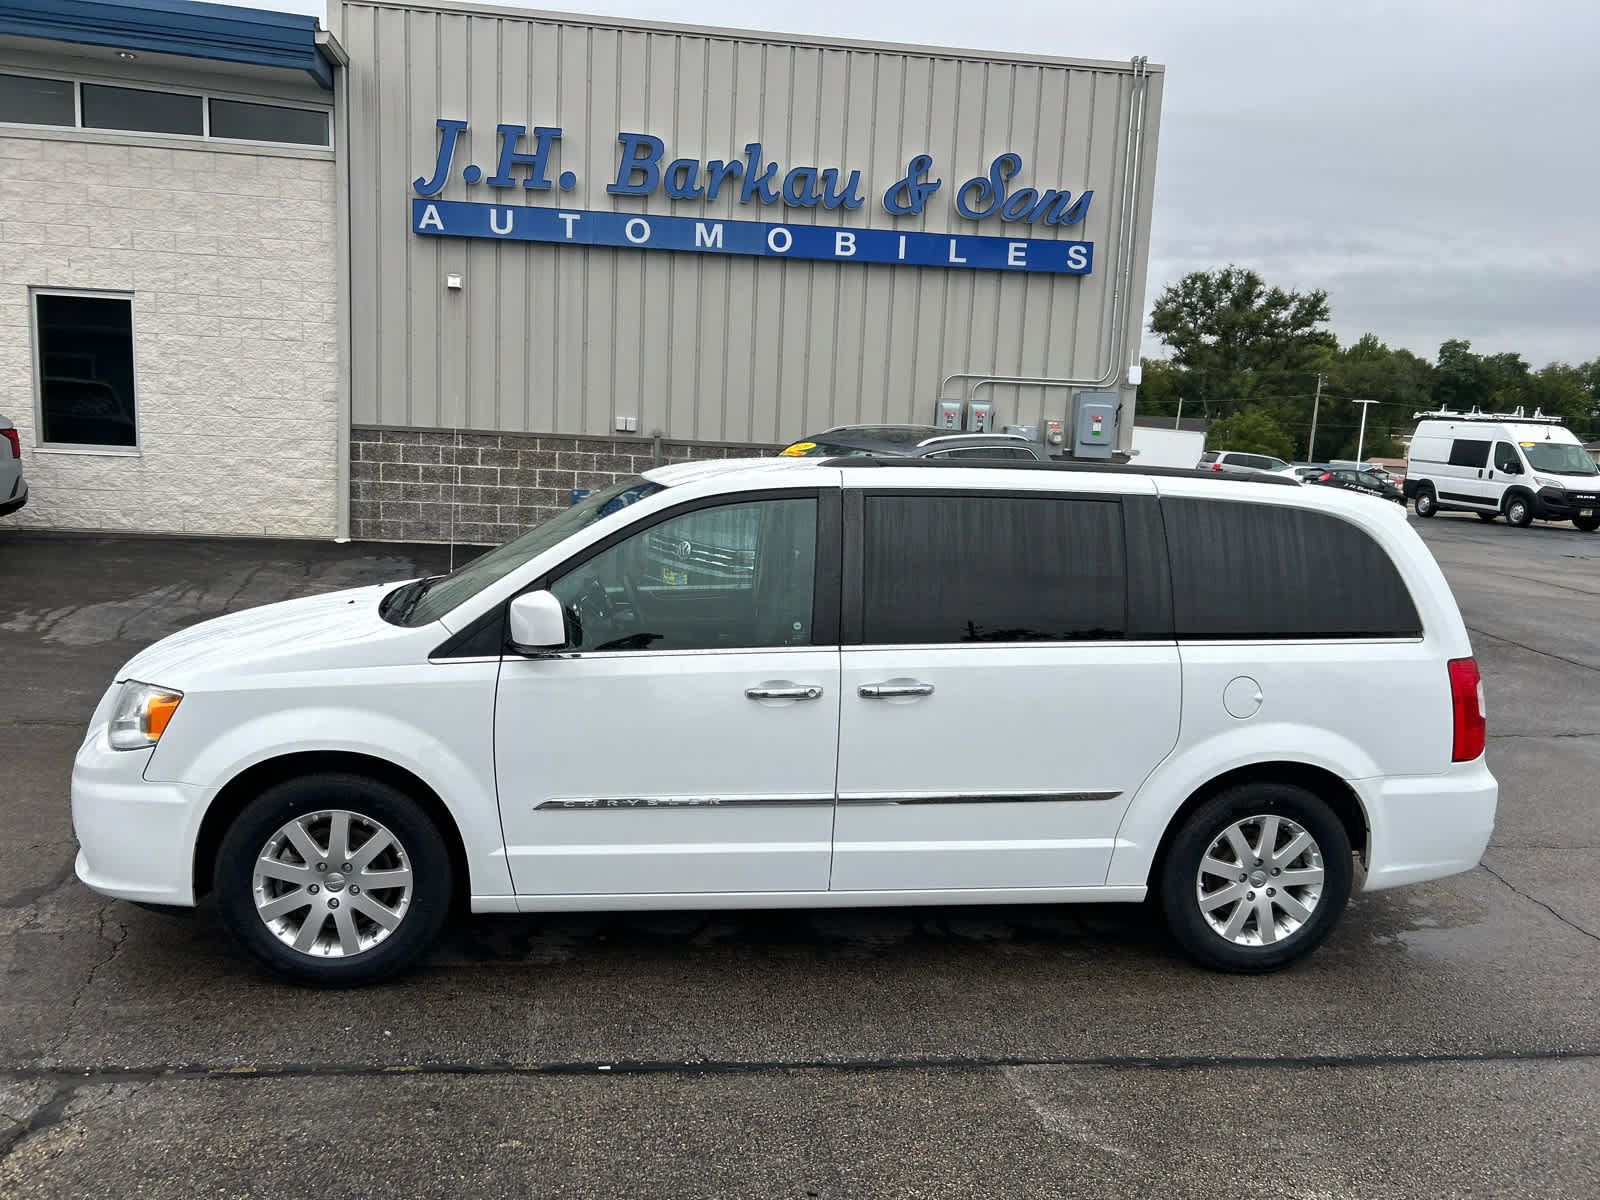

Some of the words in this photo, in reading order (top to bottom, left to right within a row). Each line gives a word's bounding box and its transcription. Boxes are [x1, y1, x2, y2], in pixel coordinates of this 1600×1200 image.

[412, 118, 577, 197] J.H.
[606, 132, 864, 209] Barkau
[883, 154, 941, 216] &
[956, 152, 1095, 226] Sons
[418, 204, 1088, 270] AUTOMOBILES
